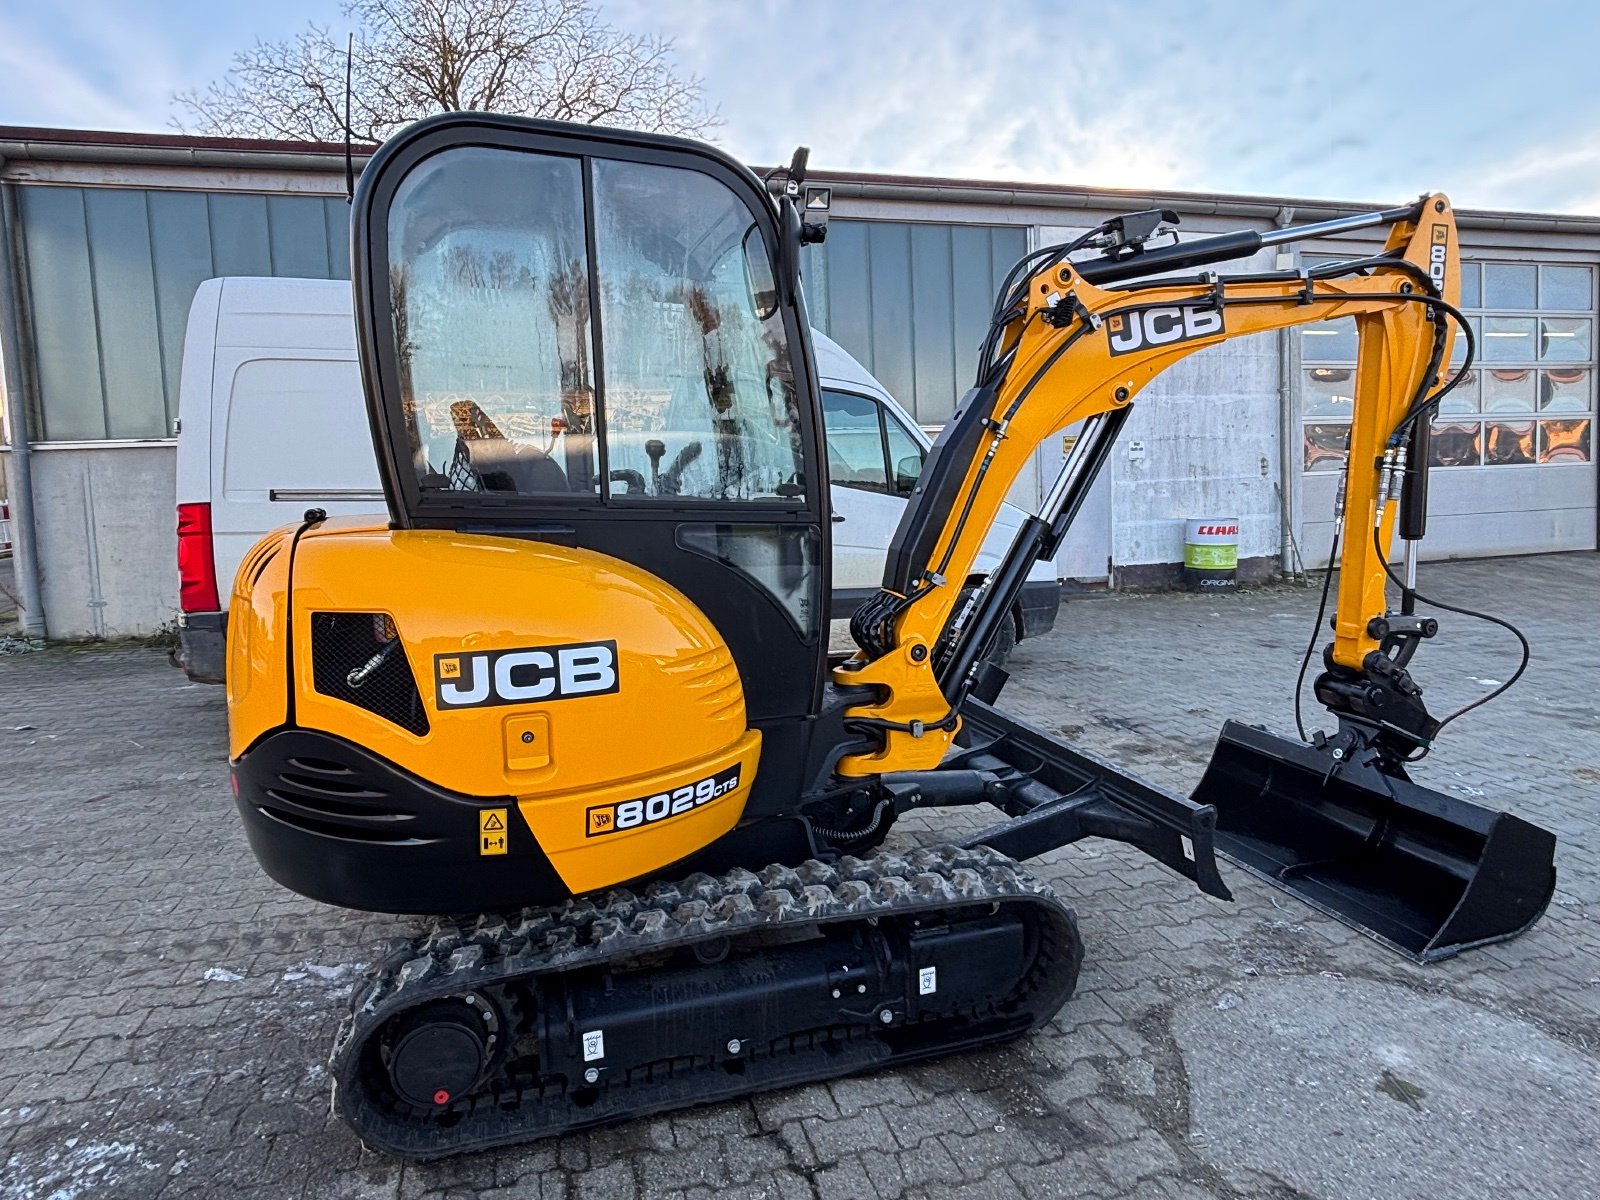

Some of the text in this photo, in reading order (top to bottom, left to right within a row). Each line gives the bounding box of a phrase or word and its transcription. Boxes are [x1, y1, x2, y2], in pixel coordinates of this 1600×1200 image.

[1111, 306, 1222, 352] JCB
[440, 646, 616, 705] JCB
[592, 813, 611, 828] JCB
